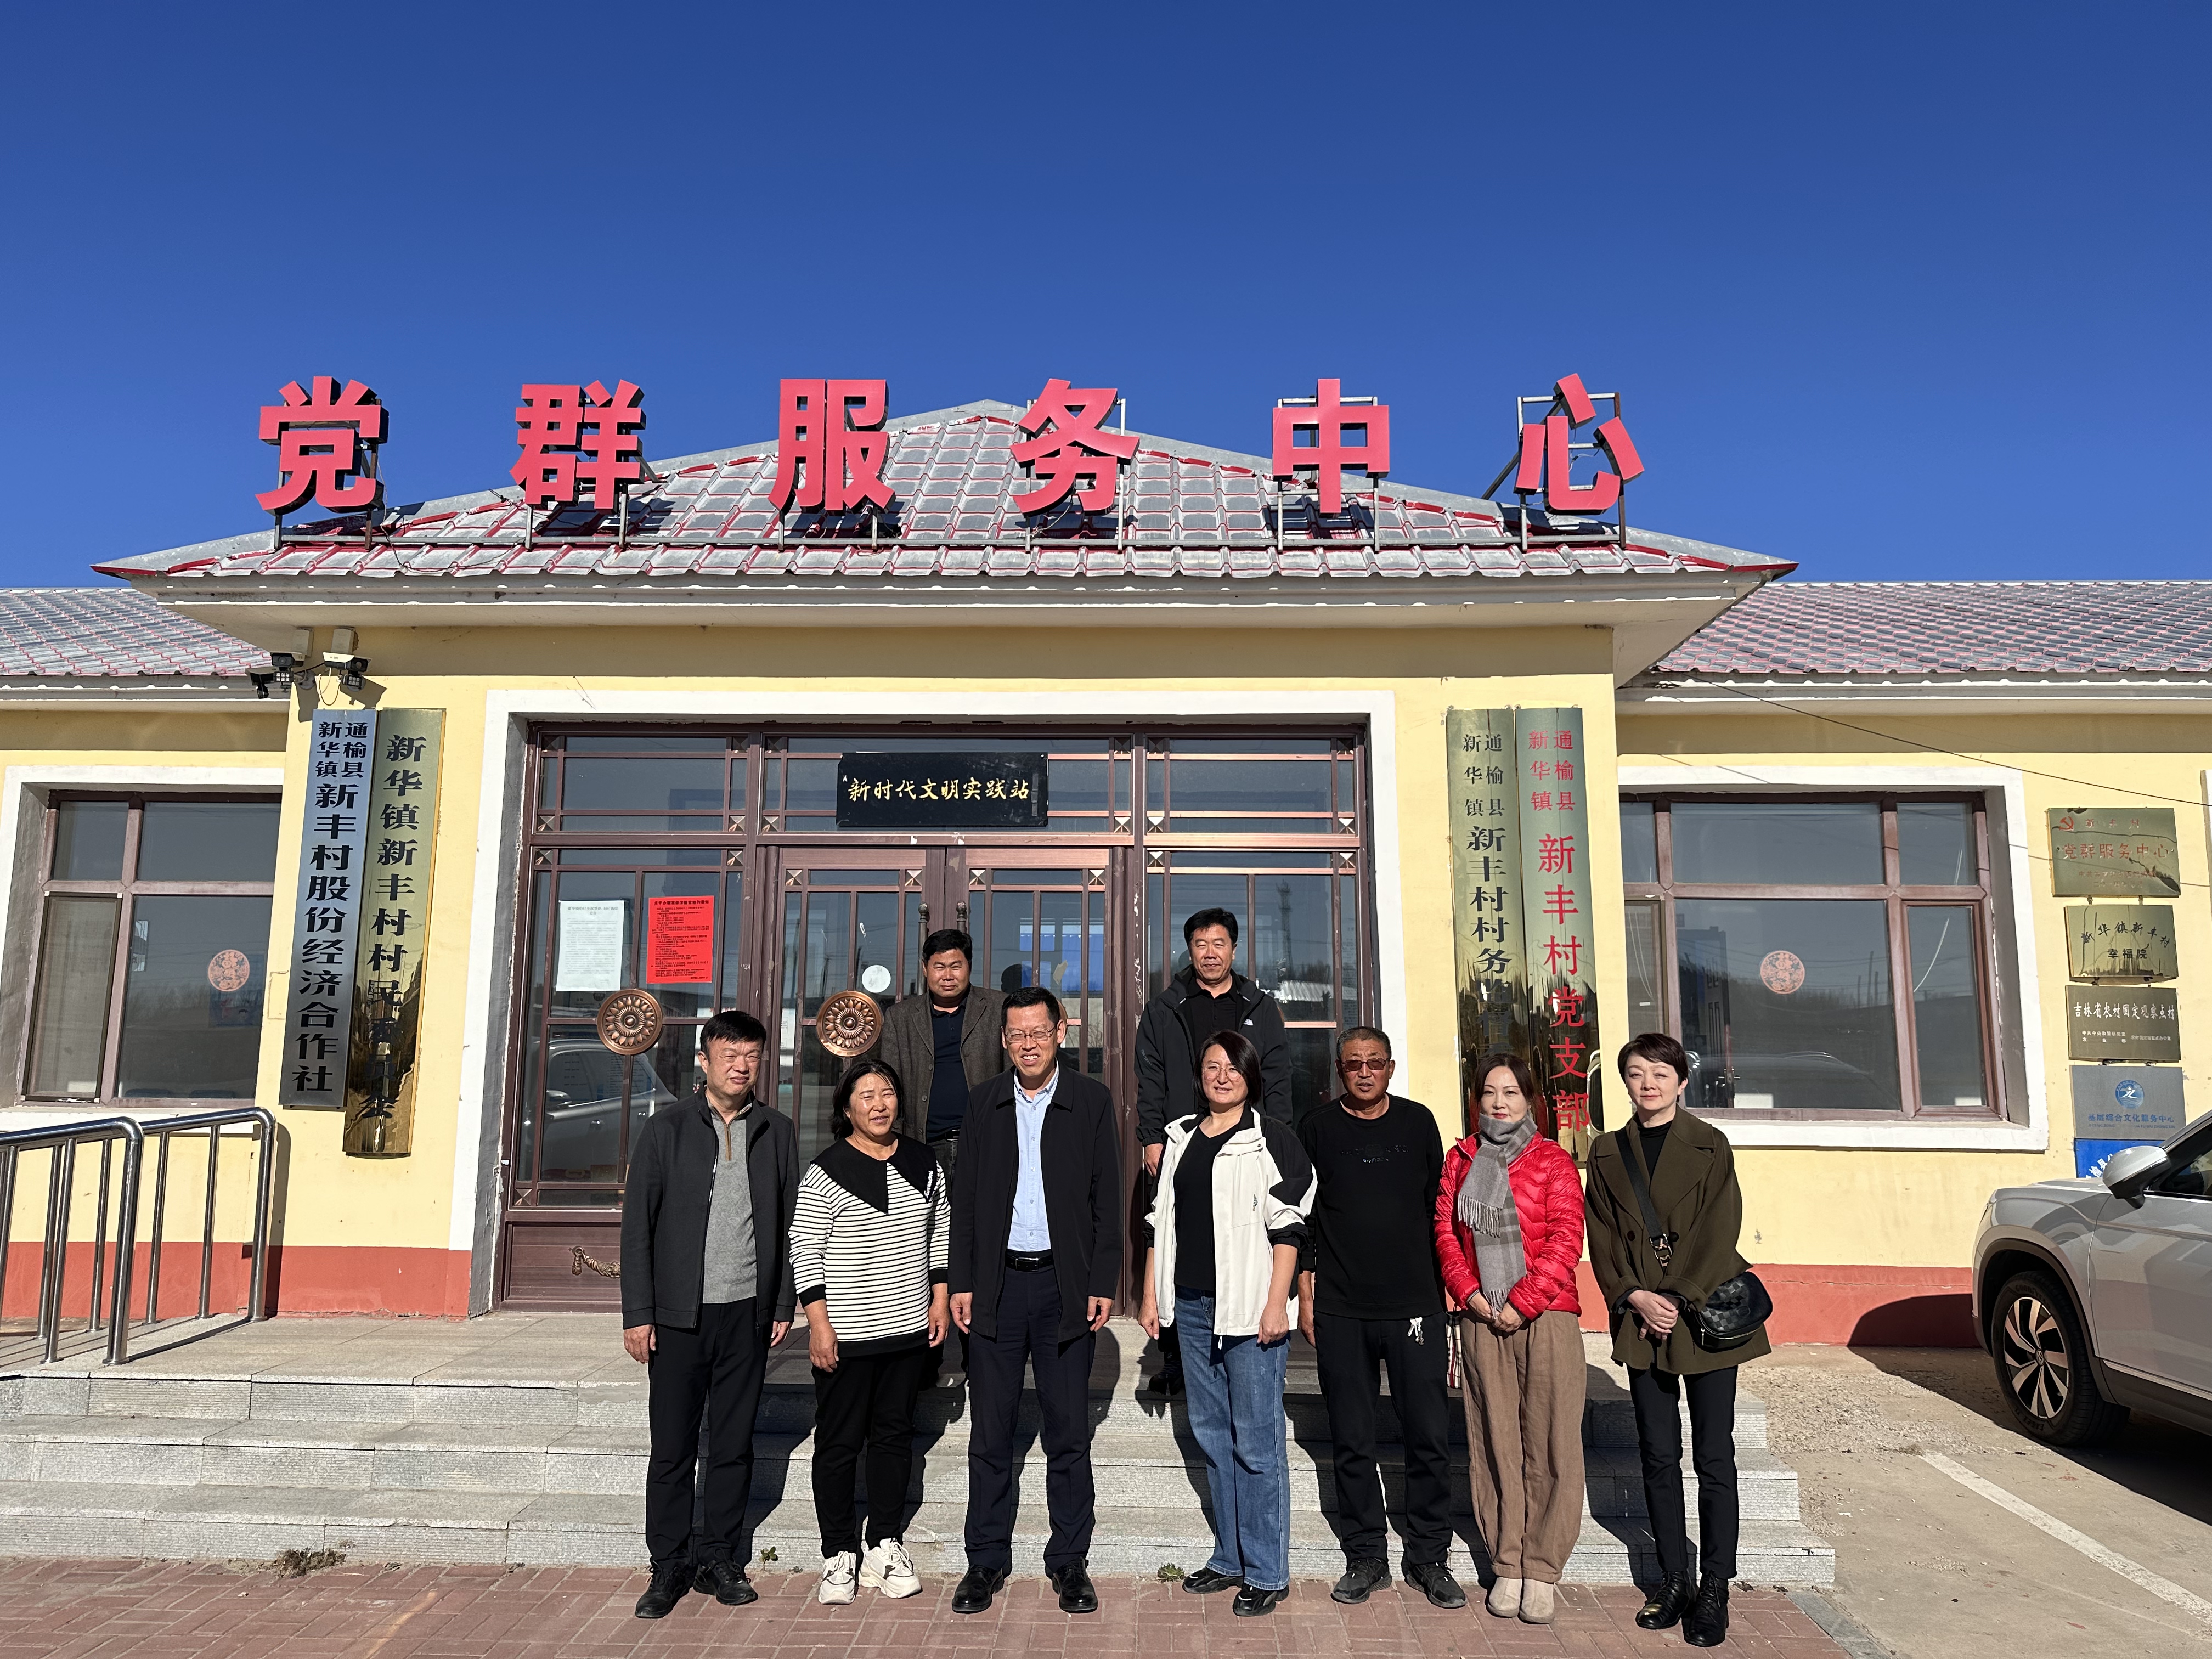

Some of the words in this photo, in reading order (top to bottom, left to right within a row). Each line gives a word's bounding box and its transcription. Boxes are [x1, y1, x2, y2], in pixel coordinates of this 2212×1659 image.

[255, 373, 1644, 516] 党群服务中心
[315, 721, 342, 778] 新华镇
[341, 721, 368, 778] 通榆县
[1462, 733, 1484, 817] 新华镇
[1484, 733, 1505, 816] 通榆县
[1528, 730, 1553, 811] 新华镇
[1553, 730, 1576, 811] 通榆县
[848, 776, 1030, 802] 新时代文明实践站
[2063, 843, 2169, 859] 党群服务中心
[292, 783, 359, 1092] 新丰村股份经济合作社
[2107, 949, 2147, 959] 幸福院
[1538, 833, 1590, 1132] 新丰村党支部
[2073, 1002, 2174, 1020] 吉林省农村固定观察点村
[2088, 1114, 2175, 1123] 基层综合文化服务中心
